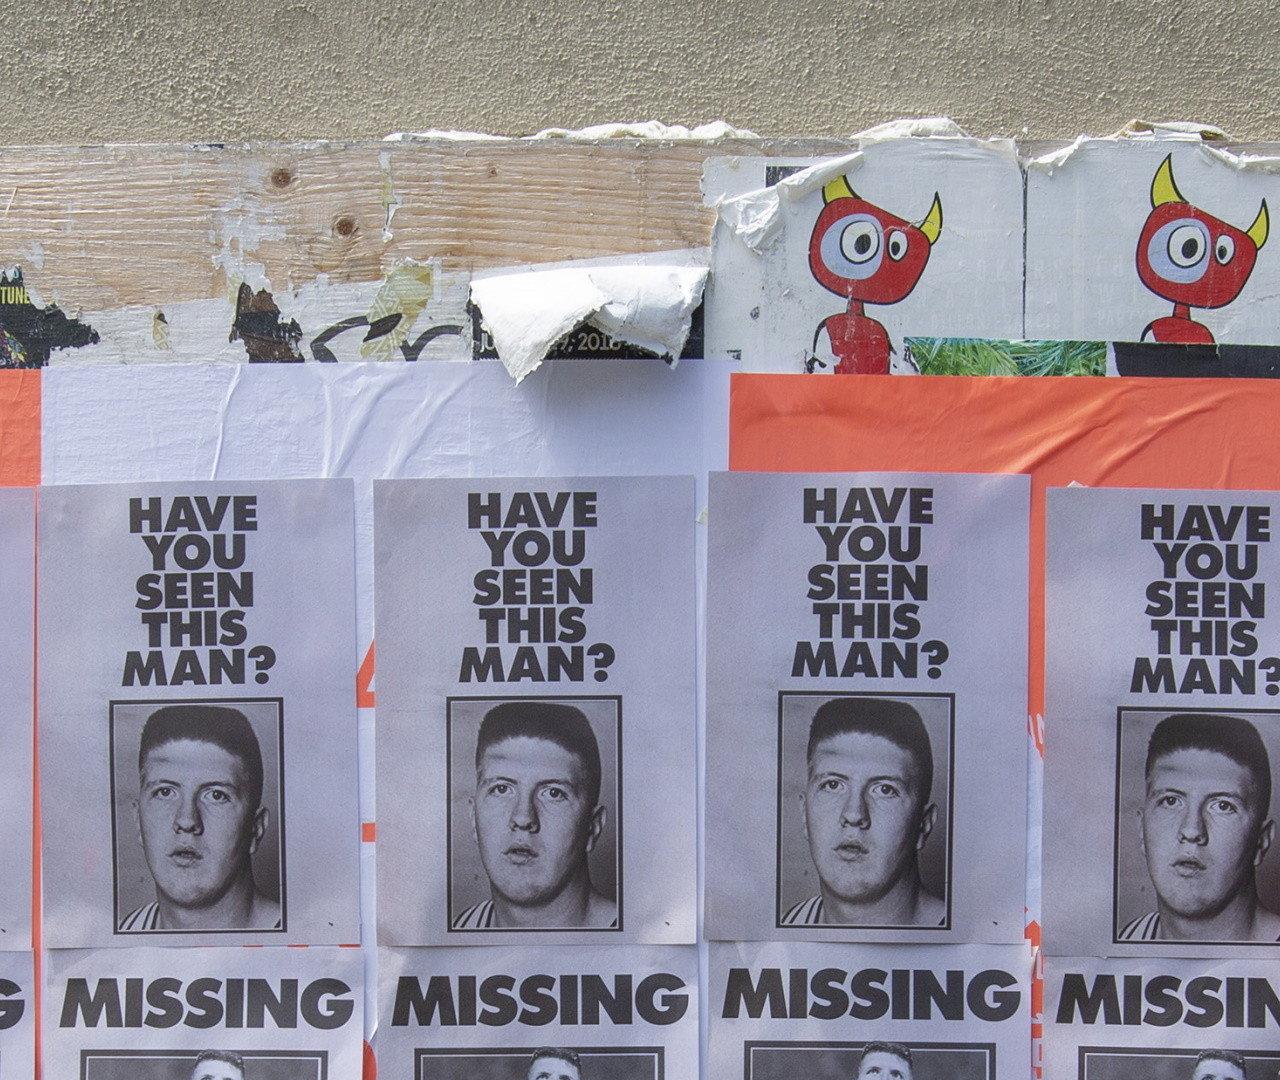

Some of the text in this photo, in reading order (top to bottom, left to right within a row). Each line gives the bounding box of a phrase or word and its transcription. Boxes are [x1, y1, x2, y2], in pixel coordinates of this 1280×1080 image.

[130, 496, 257, 533] HAVE
[468, 492, 597, 528] HAVE
[804, 488, 933, 524] HAVE
[1141, 504, 1270, 542] HAVE
[142, 534, 245, 571] YOU
[480, 530, 585, 567] YOU
[815, 526, 921, 562] YOU
[1153, 543, 1258, 580] YOU
[136, 572, 253, 610] SEEN
[473, 569, 593, 606] SEEN
[807, 564, 928, 601] SEEN
[1145, 581, 1265, 618] SEEN
[142, 610, 247, 647] THIS
[479, 607, 586, 643] THIS
[813, 603, 920, 639] THIS
[1151, 620, 1258, 656] THIS
[122, 646, 276, 686] MAN?
[459, 643, 615, 682] MAN?
[791, 640, 949, 679] MAN?
[60, 978, 354, 1029] MISSING
[391, 973, 688, 1026] MISSING
[722, 968, 1020, 1021] MISSING
